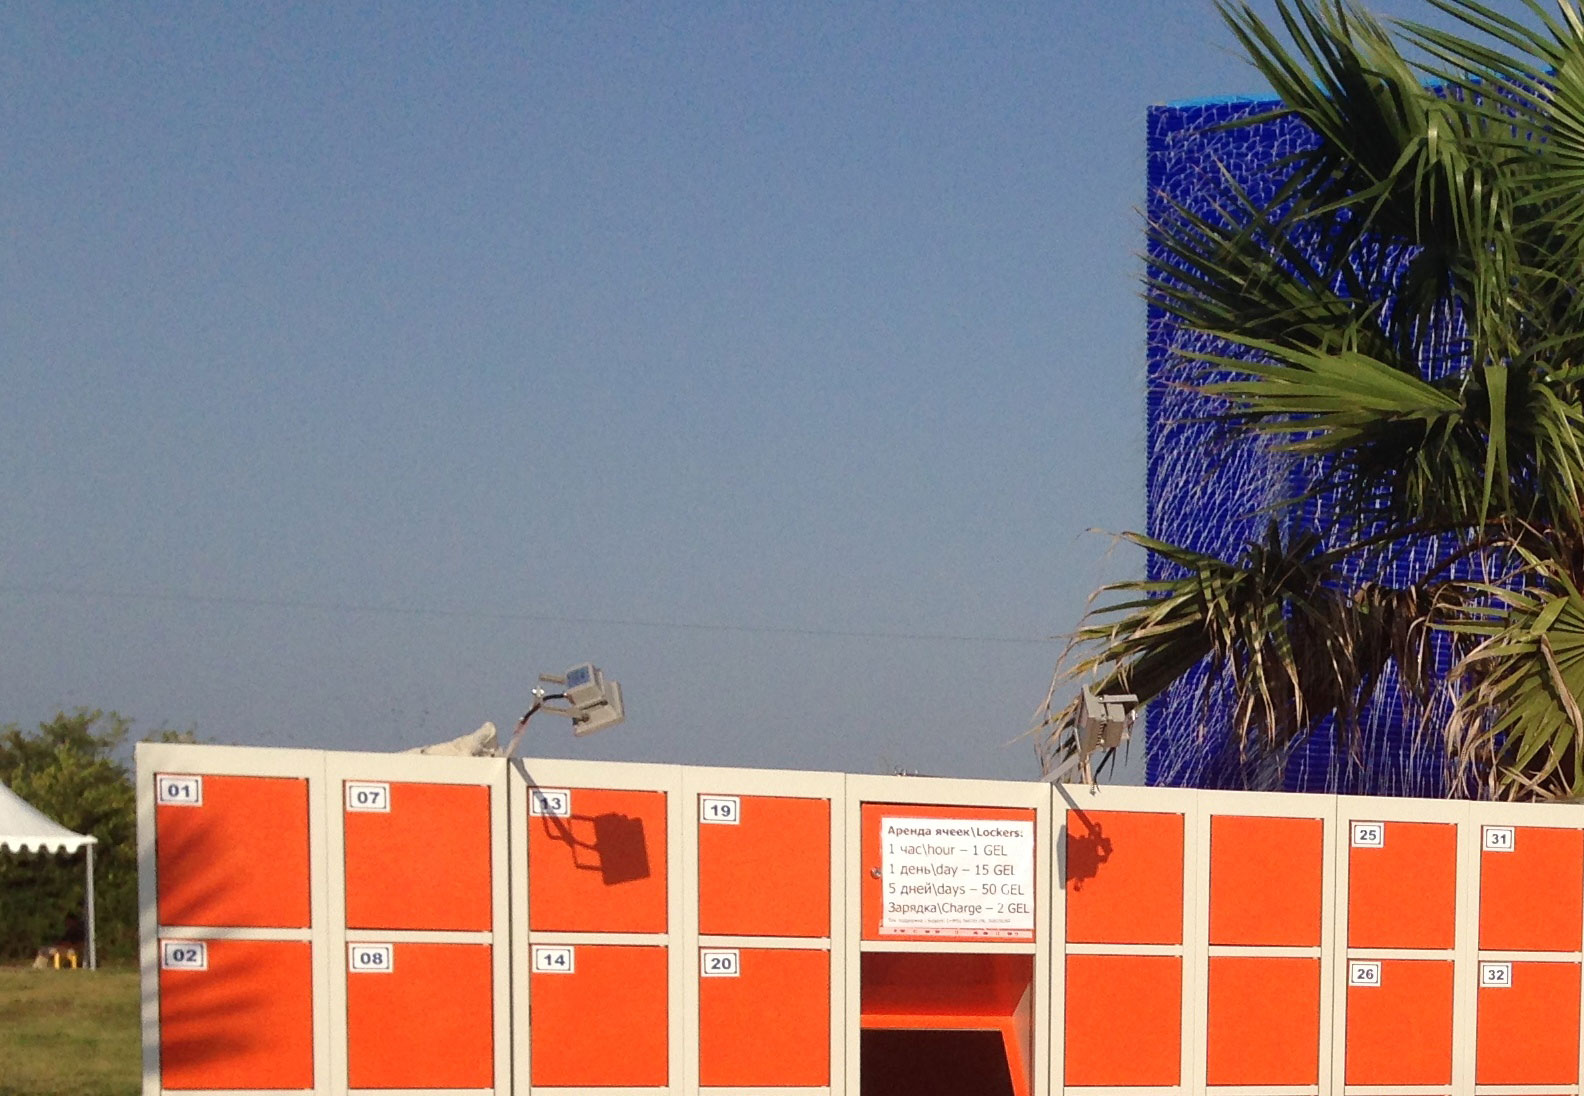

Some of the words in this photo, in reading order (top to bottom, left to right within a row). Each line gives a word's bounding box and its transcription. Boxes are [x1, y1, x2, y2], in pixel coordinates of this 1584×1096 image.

[167, 783, 190, 798] 01
[357, 791, 380, 804] 07
[539, 797, 561, 810] 13
[710, 804, 731, 817] 19
[887, 826, 932, 837] Аренда
[1359, 829, 1377, 841] 25
[1491, 833, 1506, 845] 31
[889, 843, 894, 855] 1
[900, 843, 955, 856] час\hour
[973, 845, 978, 855] 1
[984, 845, 1008, 856] GEL
[889, 864, 895, 874] 1
[900, 864, 958, 877] день\day
[975, 865, 989, 876] 15
[993, 865, 1016, 876] GEL
[888, 883, 896, 894] 5
[900, 882, 966, 896] дней\days
[982, 884, 997, 895] 50
[1001, 884, 1025, 895] GEL
[888, 902, 983, 915] Зарядка\Charge
[997, 903, 1004, 913] 2
[1007, 903, 1030, 914] GEL
[171, 947, 198, 963] 02
[360, 952, 383, 965] 08
[544, 953, 566, 966] 14
[711, 957, 732, 970] 20
[1357, 968, 1374, 980] 26
[1488, 969, 1505, 981] 32
